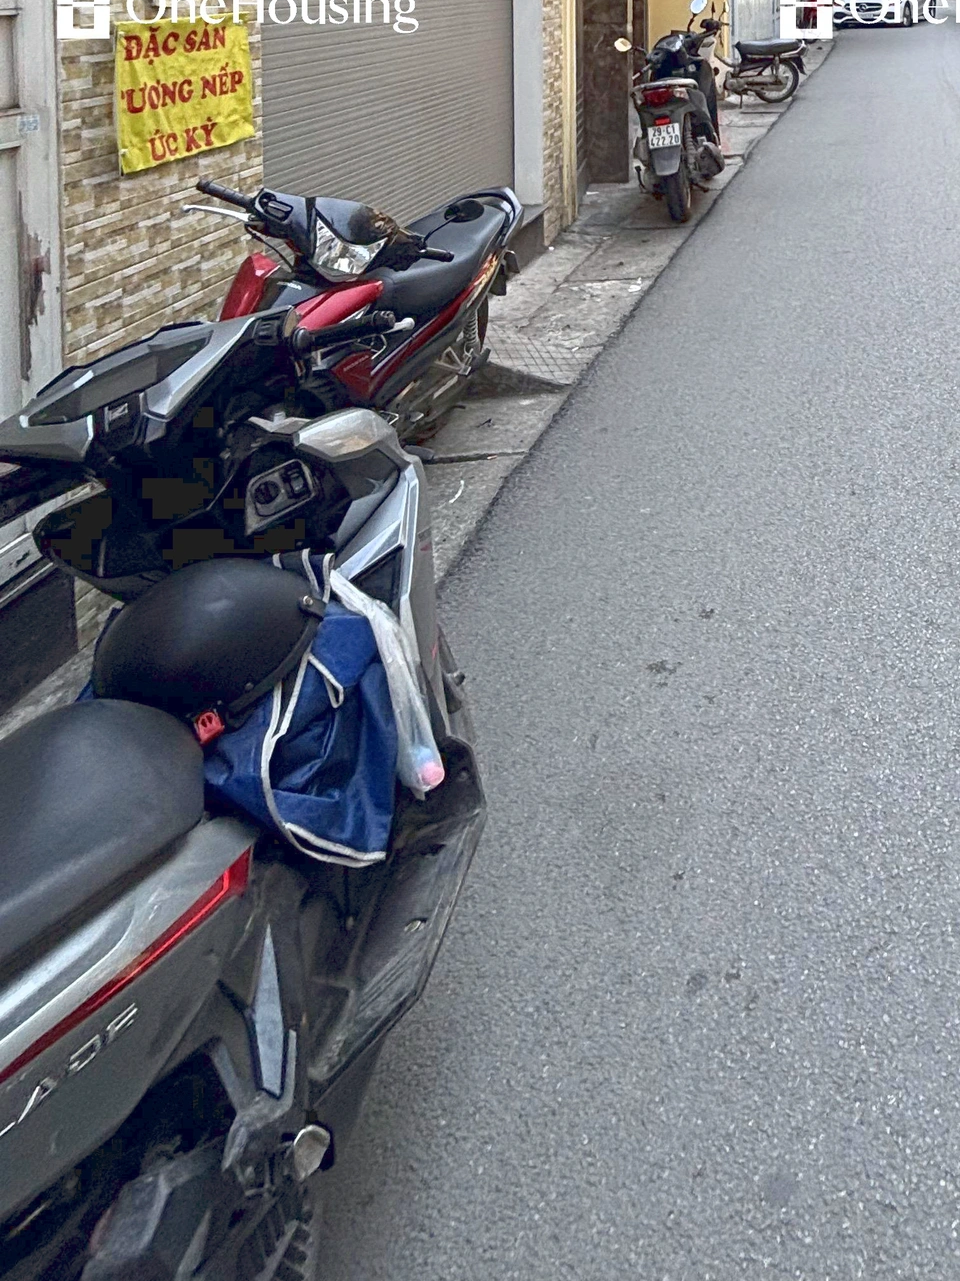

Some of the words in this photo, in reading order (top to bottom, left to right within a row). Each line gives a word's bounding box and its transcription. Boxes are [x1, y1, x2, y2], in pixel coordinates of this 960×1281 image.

[123, 26, 180, 65] ĐẶC
[183, 22, 227, 54] SẢN
[121, 79, 194, 115] ƯƠNG
[200, 62, 244, 99] NẾP
